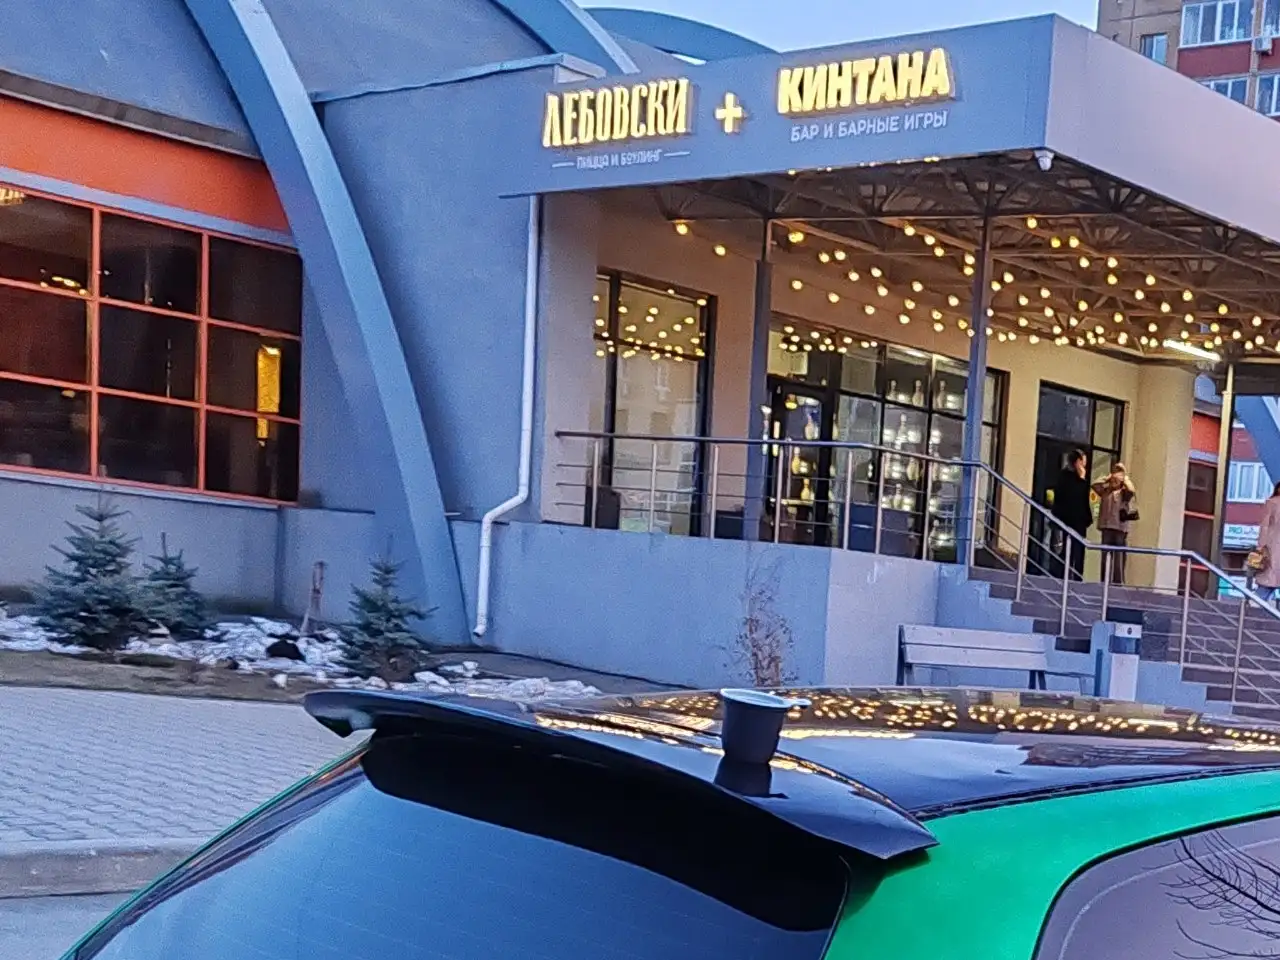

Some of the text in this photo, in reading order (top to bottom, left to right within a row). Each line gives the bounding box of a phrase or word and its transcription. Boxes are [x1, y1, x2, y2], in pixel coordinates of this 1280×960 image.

[542, 78, 690, 148] ЛЕБОВСКИ
[777, 47, 950, 114] КИНТАНА
[791, 109, 948, 142] БАР И БАРНЫЕ ИГРЫ
